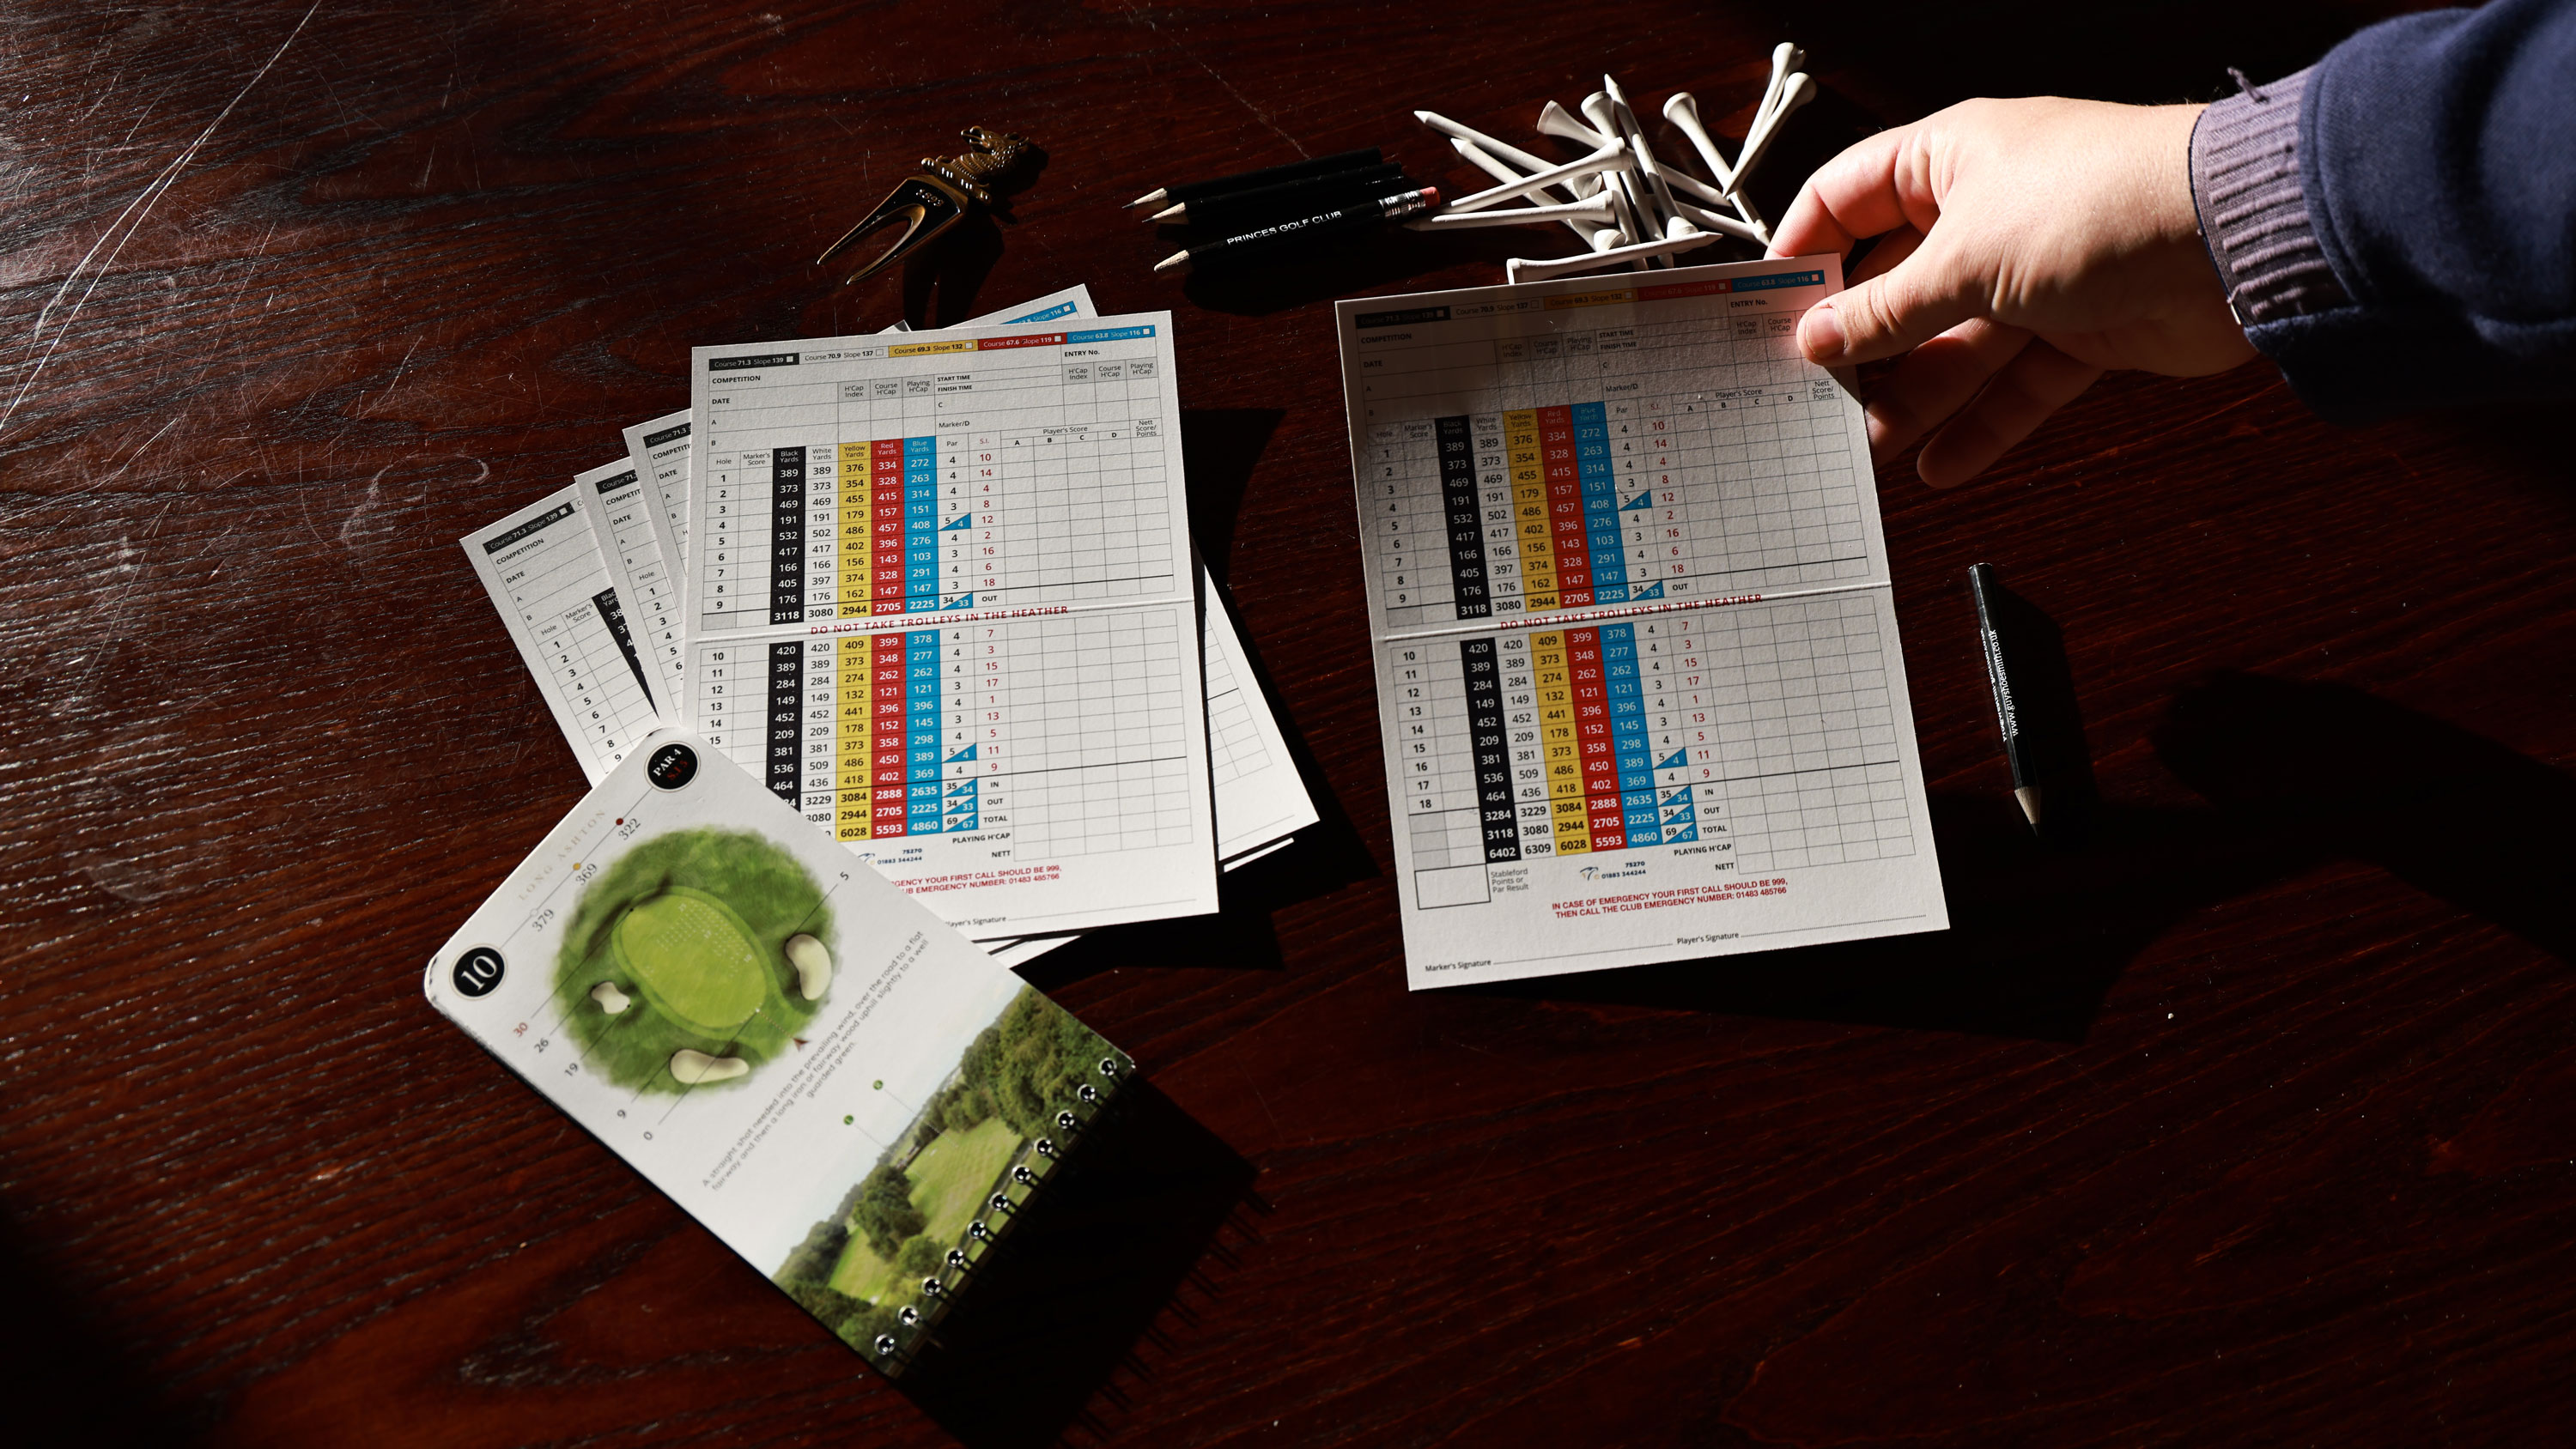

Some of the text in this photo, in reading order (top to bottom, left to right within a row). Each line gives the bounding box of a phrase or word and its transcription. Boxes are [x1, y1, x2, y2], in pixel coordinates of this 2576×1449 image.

[1227, 211, 1341, 245] PRINCES GOLF CLUB
[1730, 300, 1753, 308] ENTRY
[712, 375, 761, 384] COMPETITION
[1716, 388, 1764, 398] Player's Score
[781, 469, 798, 477] 389
[813, 466, 831, 475] 389
[846, 464, 864, 472] 376
[878, 461, 896, 470] 334
[911, 458, 929, 467] 272
[490, 512, 557, 549] Course 71.3 Slope 139
[496, 538, 544, 565] COMPETITION
[506, 571, 525, 584] DATE
[811, 626, 829, 634] DO
[834, 623, 860, 634] NOT
[864, 621, 895, 630] TAKE
[900, 615, 961, 627] TROLLEYS
[984, 611, 1006, 620] THE
[1012, 606, 1069, 618] HEATHER
[1501, 594, 1763, 630] DO NOT TAKE TROLLEYS IN THE HEATHER
[1988, 630, 2018, 737] www.guyshoesmith.co.uk
[653, 756, 676, 776] PAR
[557, 809, 605, 862] ASHTON
[618, 818, 641, 841] 322
[1703, 825, 1727, 834] TOTAL
[1490, 828, 1692, 858] 6402 6309 6028 5593 4860 69 67
[1674, 843, 1731, 856] PLAYING H'CAP
[519, 865, 553, 901] LONG
[575, 863, 598, 886] 369
[840, 871, 848, 881] 5
[1491, 868, 1528, 878] Stableford
[1556, 910, 1577, 919] THEN
[1602, 905, 1618, 913] THE
[1619, 903, 1642, 912] CLUB
[1643, 897, 1694, 909] EMERGENCY
[1697, 893, 1735, 902] NUMBER:
[1735, 889, 1759, 899] 01483
[1760, 887, 1787, 895] 485766
[1563, 900, 1583, 909] CASE
[1599, 893, 1649, 905] EMERGENCY
[1652, 890, 1675, 899] YOUR
[1677, 887, 1699, 896] FIRST
[1701, 885, 1722, 894] CALL
[1724, 882, 1758, 891] SHOULD
[532, 909, 555, 932] 379
[1677, 933, 1739, 945] Player's Signature
[461, 955, 498, 991] 10
[1425, 960, 1491, 972] Marker's Signature
[513, 1022, 528, 1037] 30
[534, 1039, 549, 1053] 26
[709, 1148, 738, 1179] straight
[737, 1128, 752, 1146] shot
[752, 1099, 778, 1128] needed
[777, 1082, 792, 1098] into
[792, 1069, 804, 1082] the
[803, 1030, 837, 1069] prevailing
[855, 993, 870, 1009] over
[870, 978, 882, 991] the
[881, 960, 897, 978] road
[909, 931, 922, 944] flat
[565, 1063, 578, 1076] 19
[712, 1160, 740, 1191] fairway
[739, 1143, 754, 1159] and
[754, 1124, 770, 1142] then
[775, 1098, 793, 1117] long
[791, 1082, 805, 1098] iron
[813, 1043, 840, 1073] fairway
[840, 1021, 859, 1041] wood
[859, 999, 878, 1020] uphill
[877, 972, 902, 999] slightly
[913, 939, 927, 955] well
[806, 1064, 836, 1098] guarded
[617, 1109, 626, 1118] 9
[643, 1131, 653, 1140] 0
